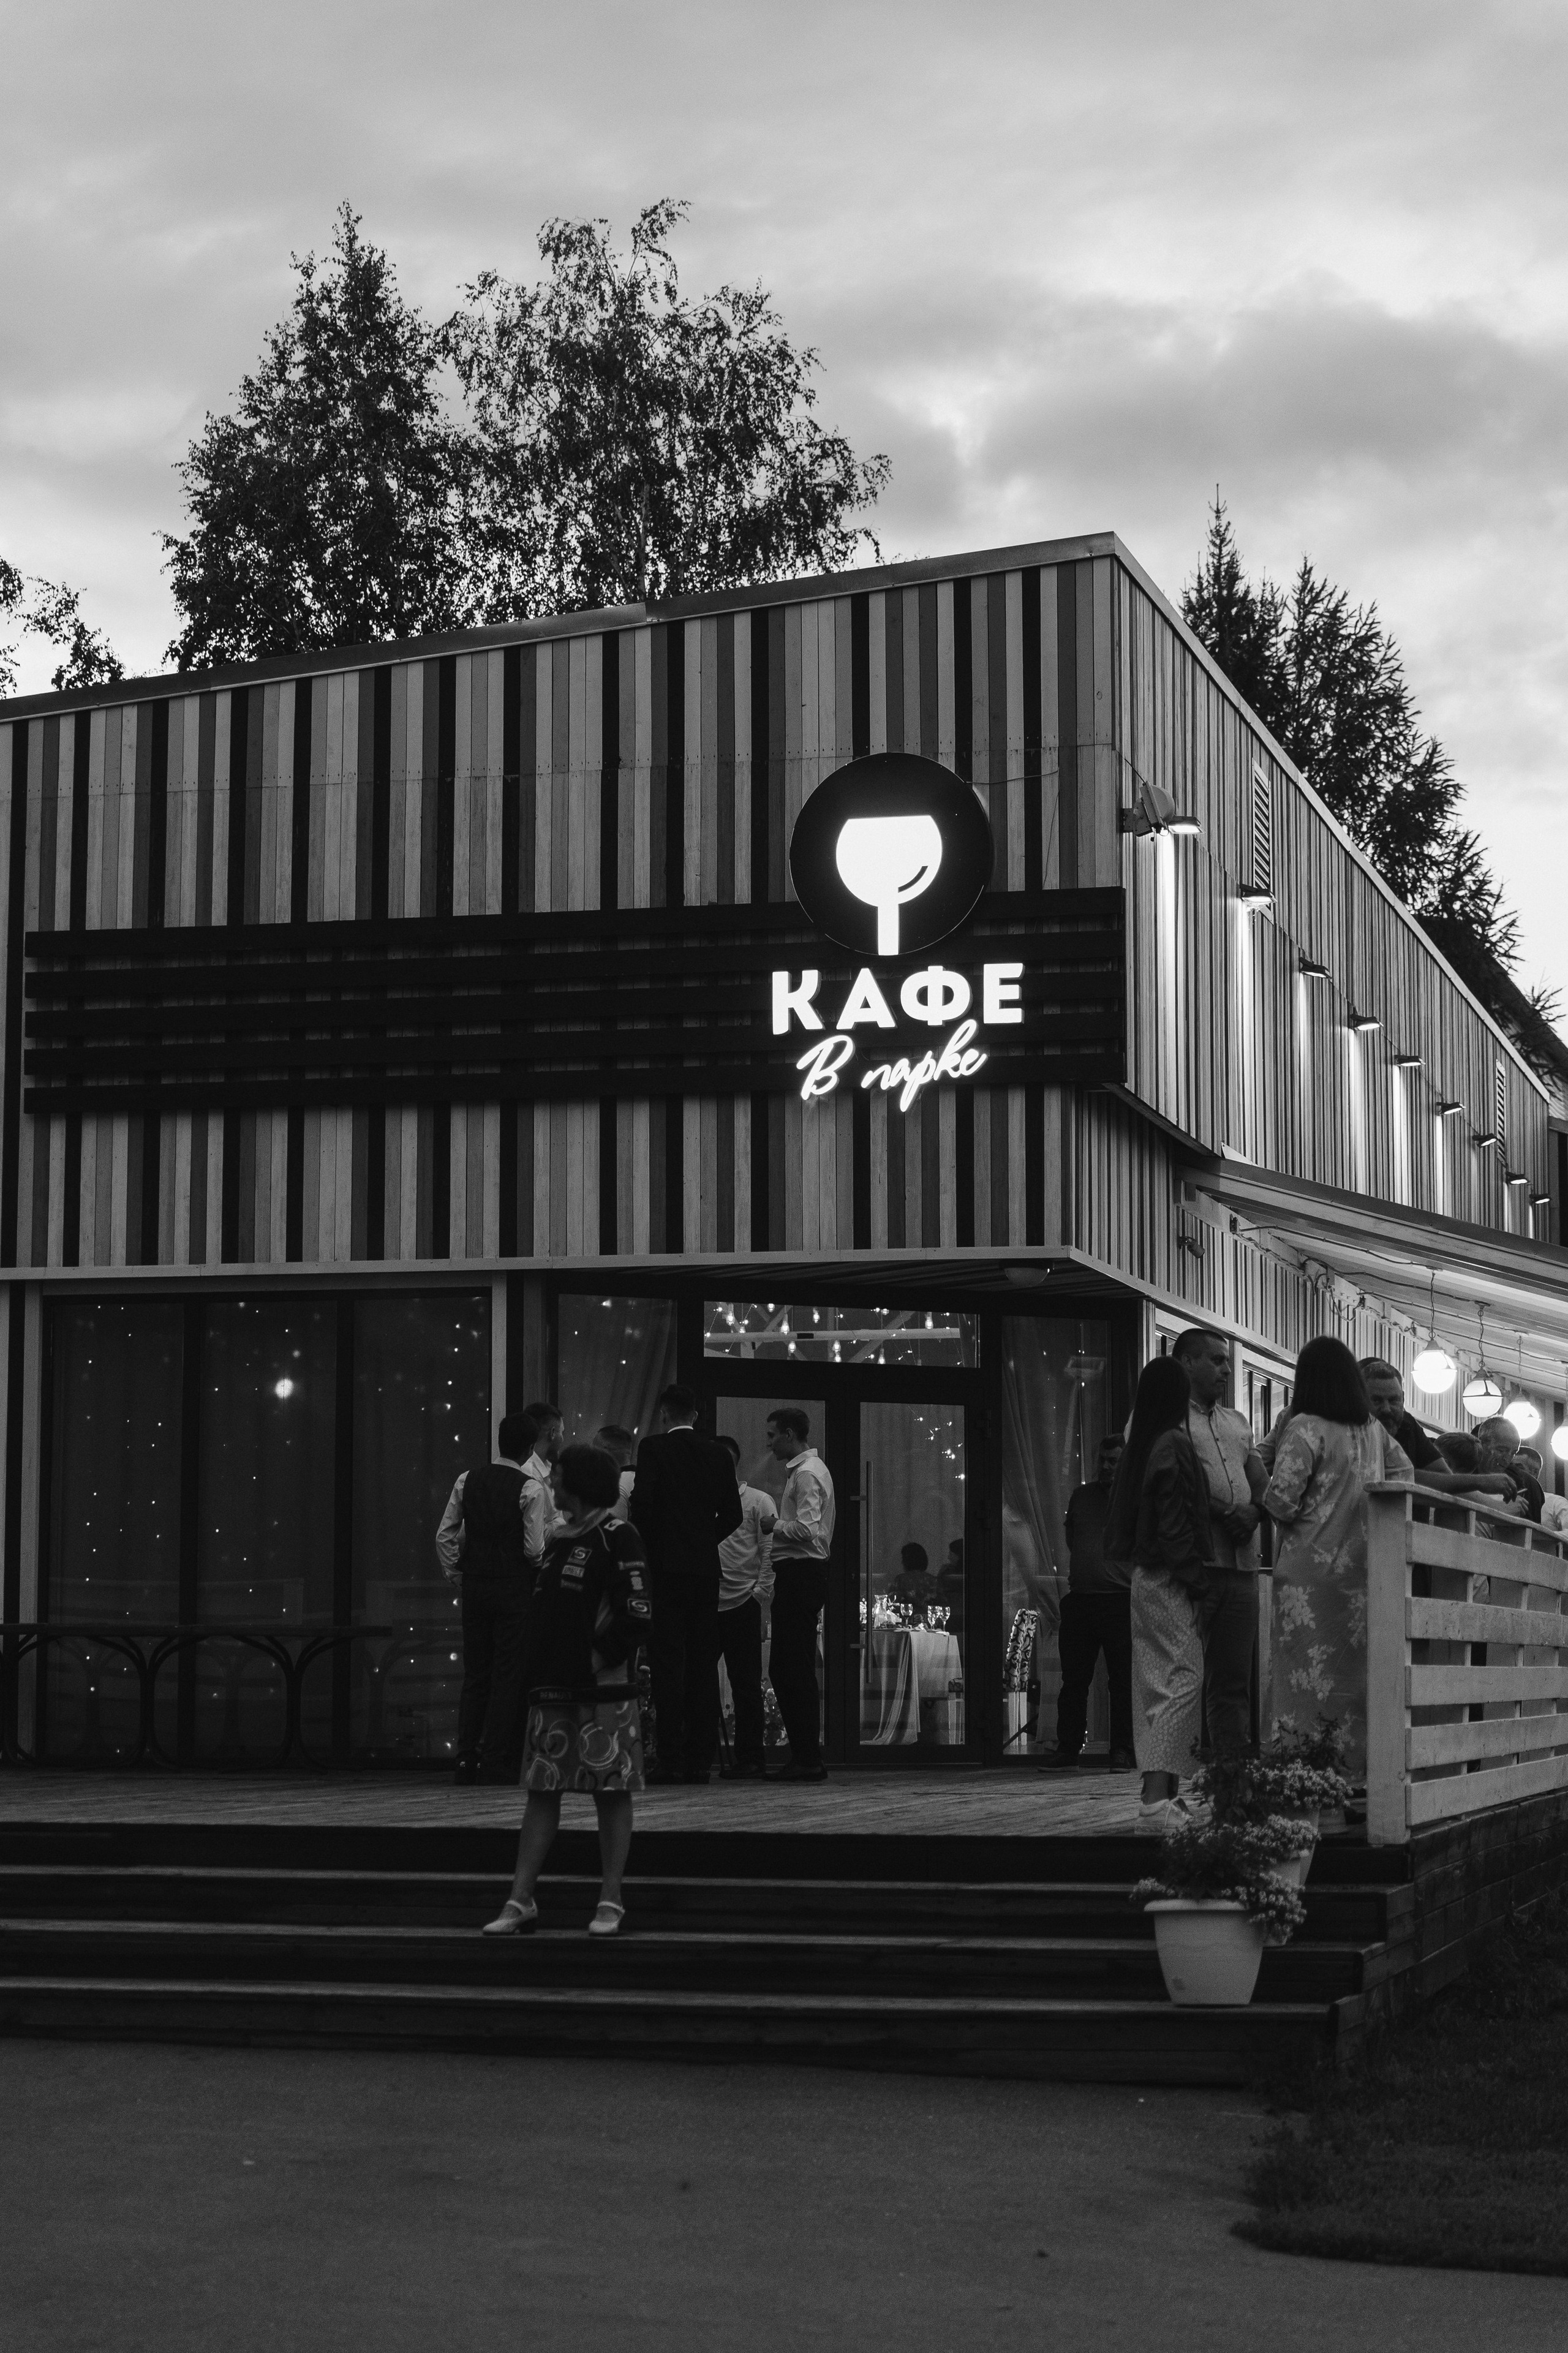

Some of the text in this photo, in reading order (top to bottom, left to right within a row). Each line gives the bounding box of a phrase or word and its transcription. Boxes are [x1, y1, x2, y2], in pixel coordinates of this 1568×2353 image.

[772, 962, 1024, 1035] КАФЕ
[796, 1018, 988, 1112] В парке
